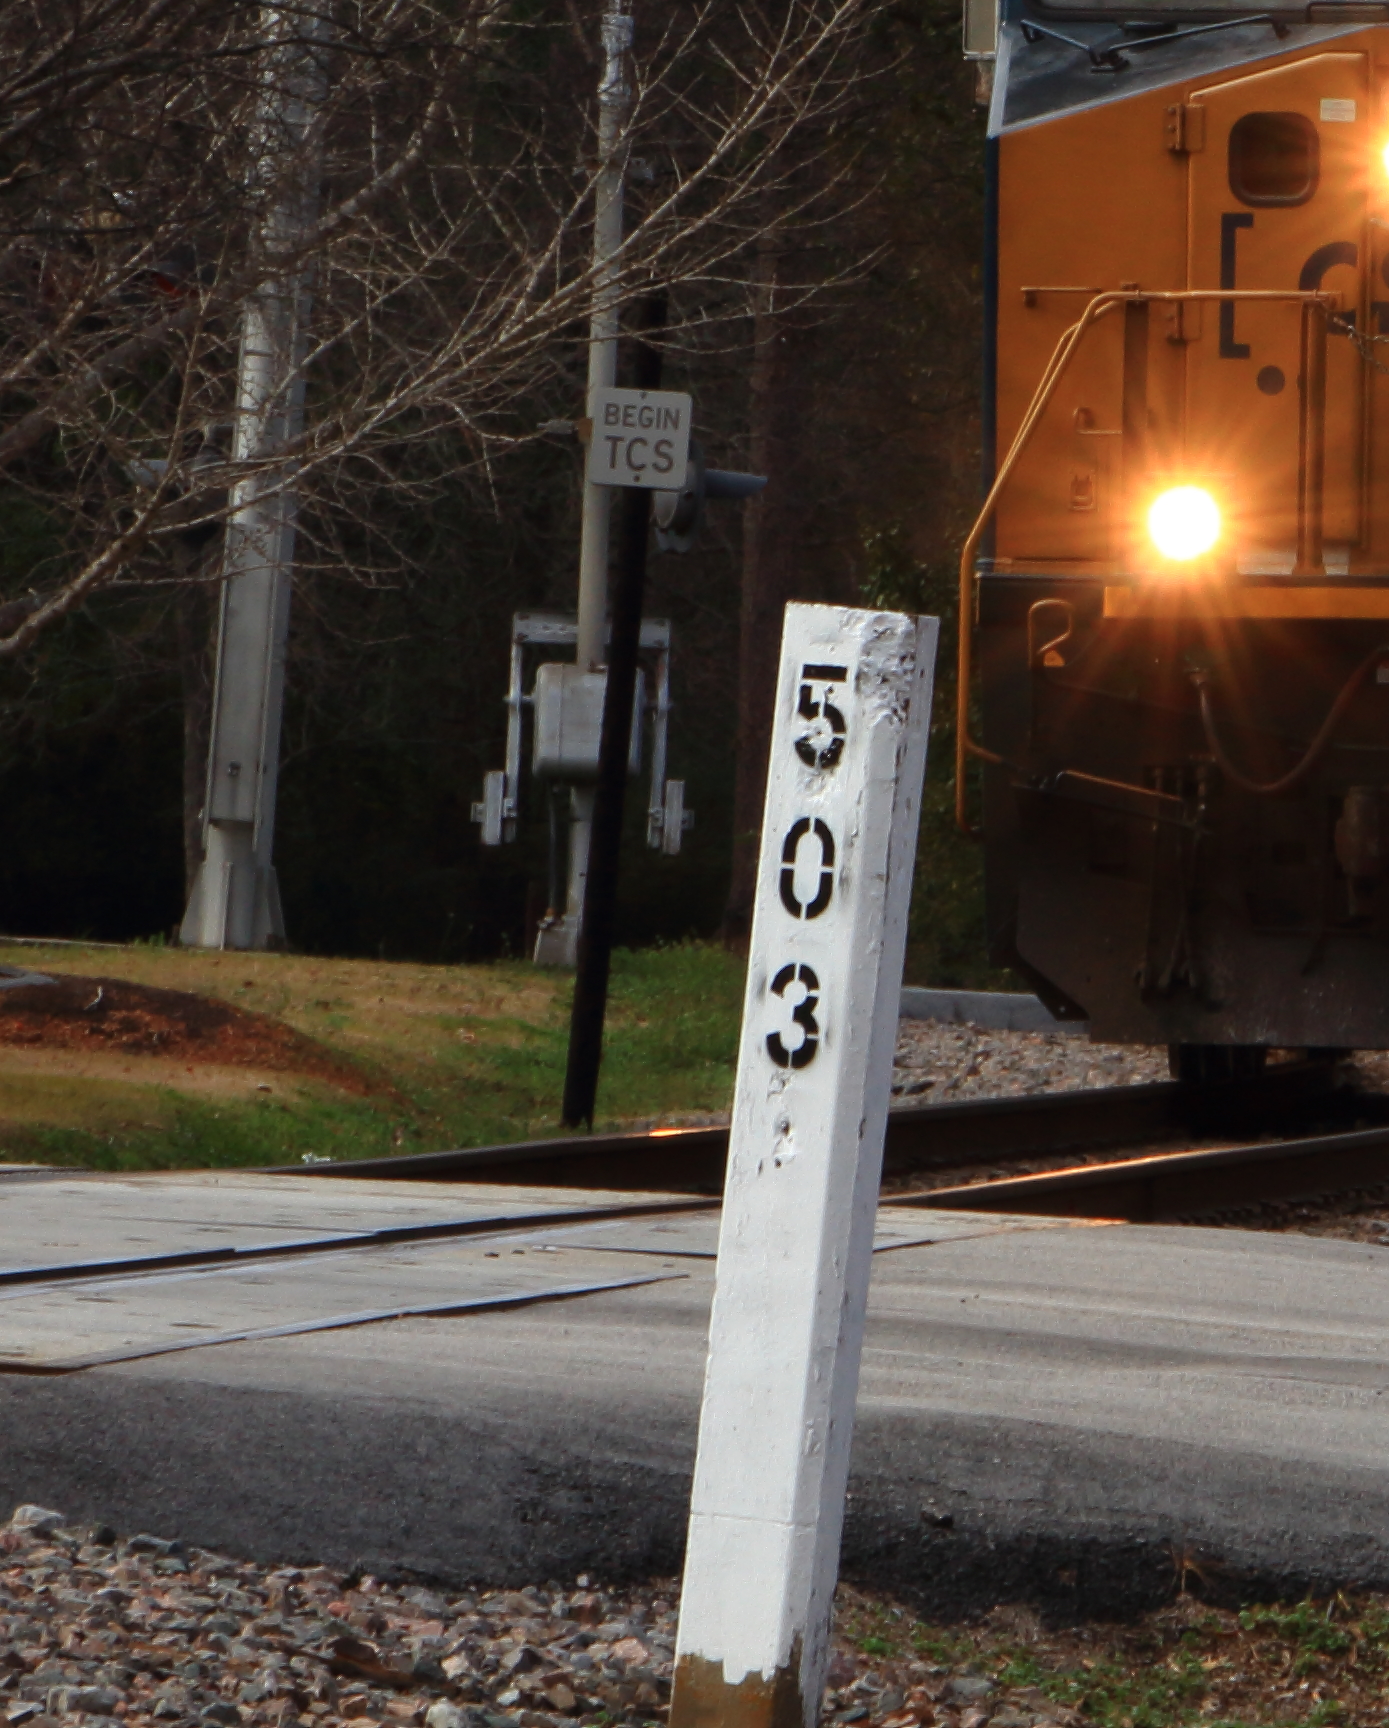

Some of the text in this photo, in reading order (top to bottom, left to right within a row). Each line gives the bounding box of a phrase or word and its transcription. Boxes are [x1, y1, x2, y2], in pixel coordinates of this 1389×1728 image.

[604, 403, 681, 430] BEGIN
[604, 435, 675, 474] TCS
[765, 663, 849, 1070] 503
